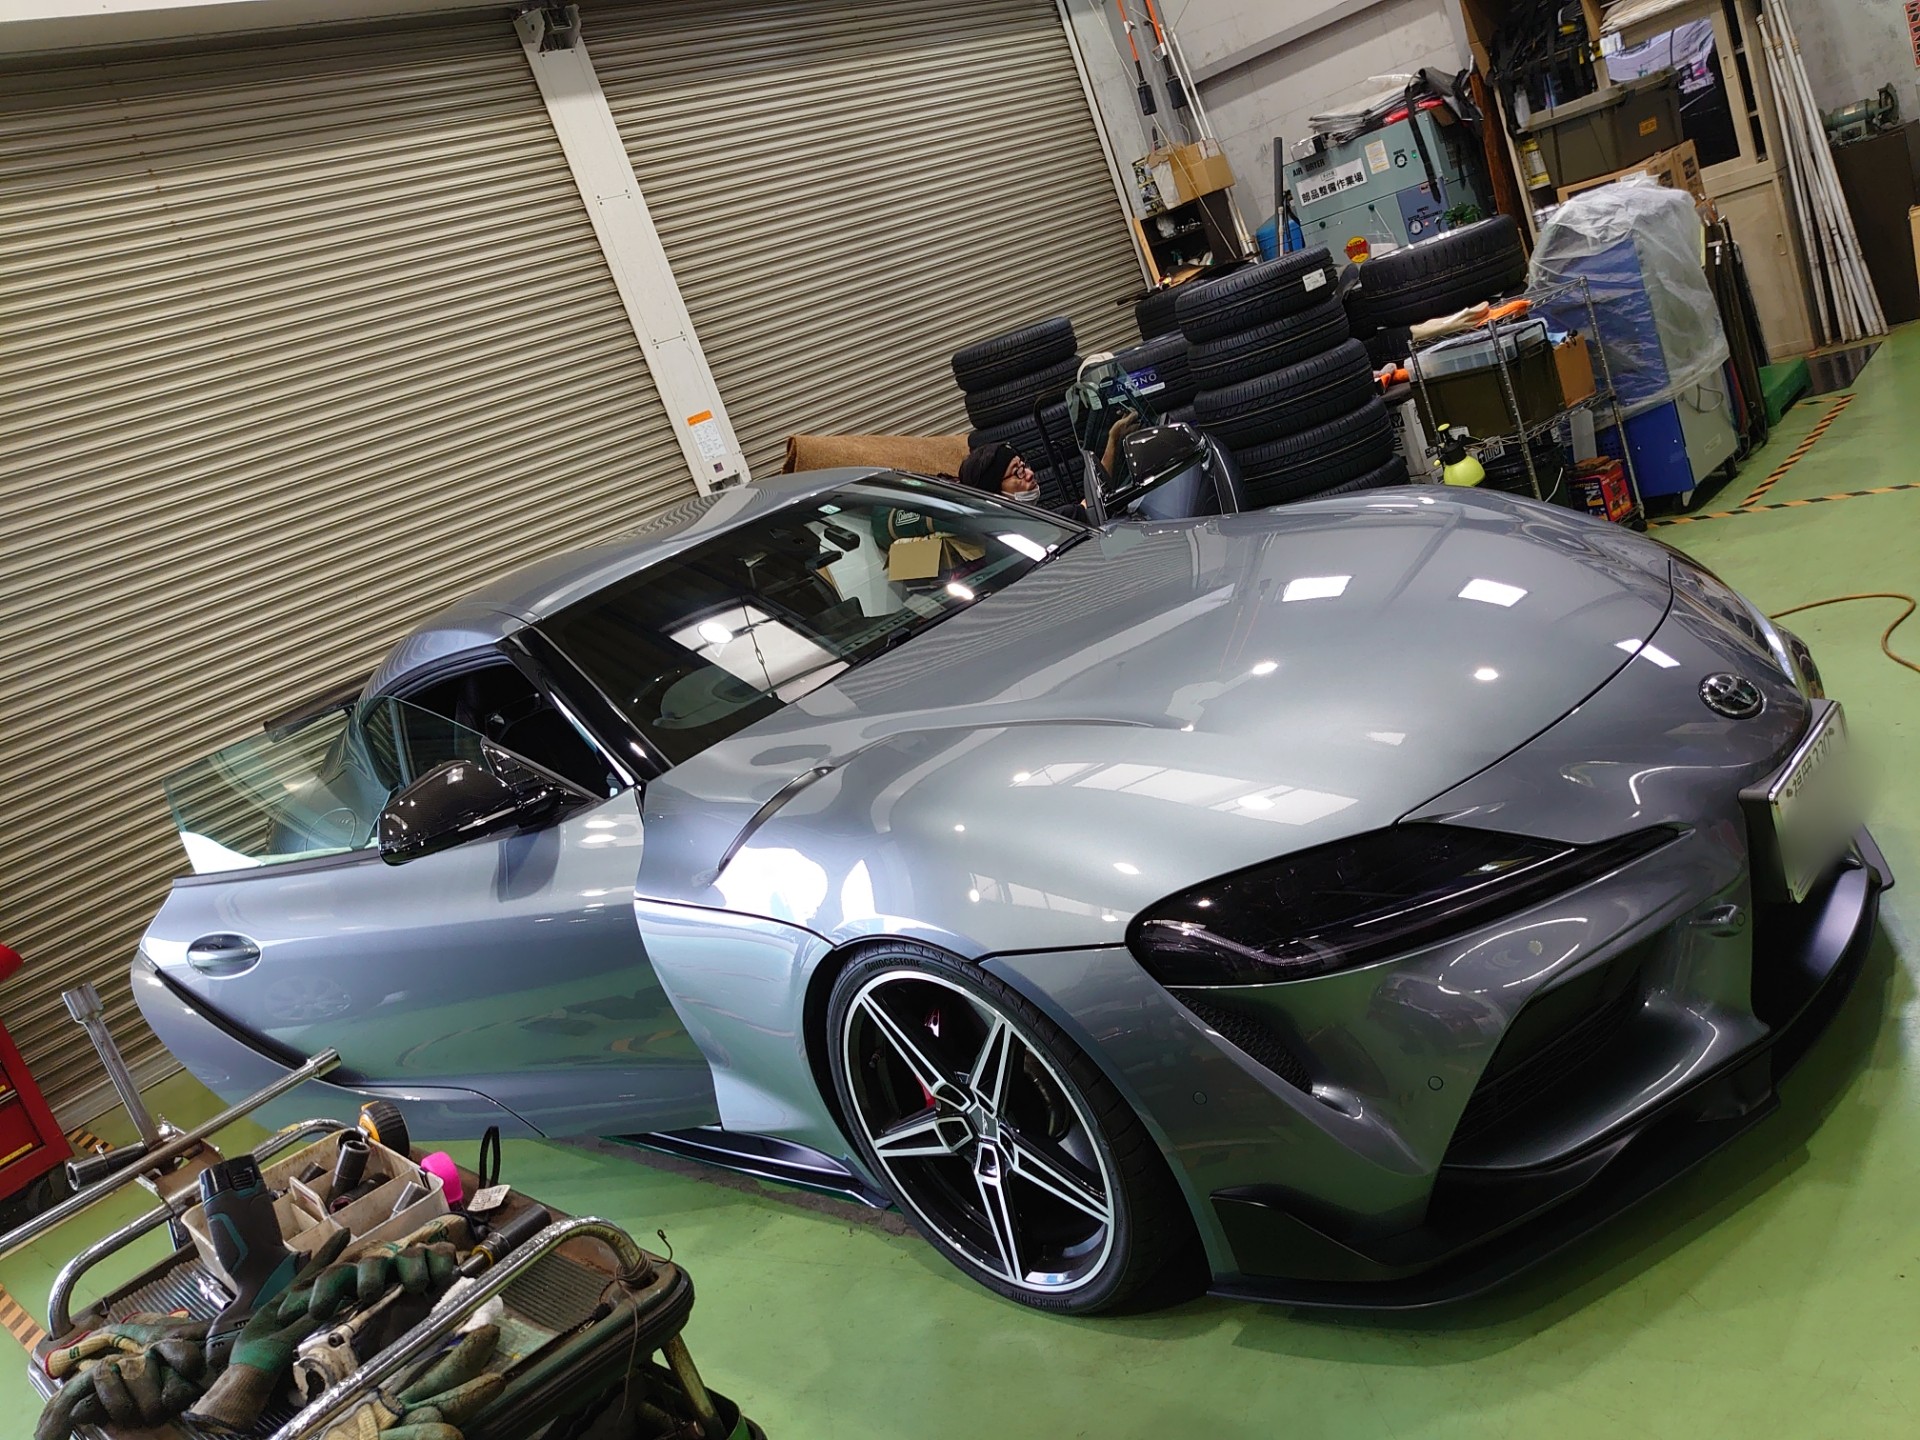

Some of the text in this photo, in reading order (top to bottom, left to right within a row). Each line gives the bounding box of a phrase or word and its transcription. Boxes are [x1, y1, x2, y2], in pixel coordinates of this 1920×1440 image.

[1292, 159, 1326, 177] AIR DRYER
[1301, 171, 1364, 204] 部品整備作業場
[864, 957, 921, 972] BRIDGESTONE
